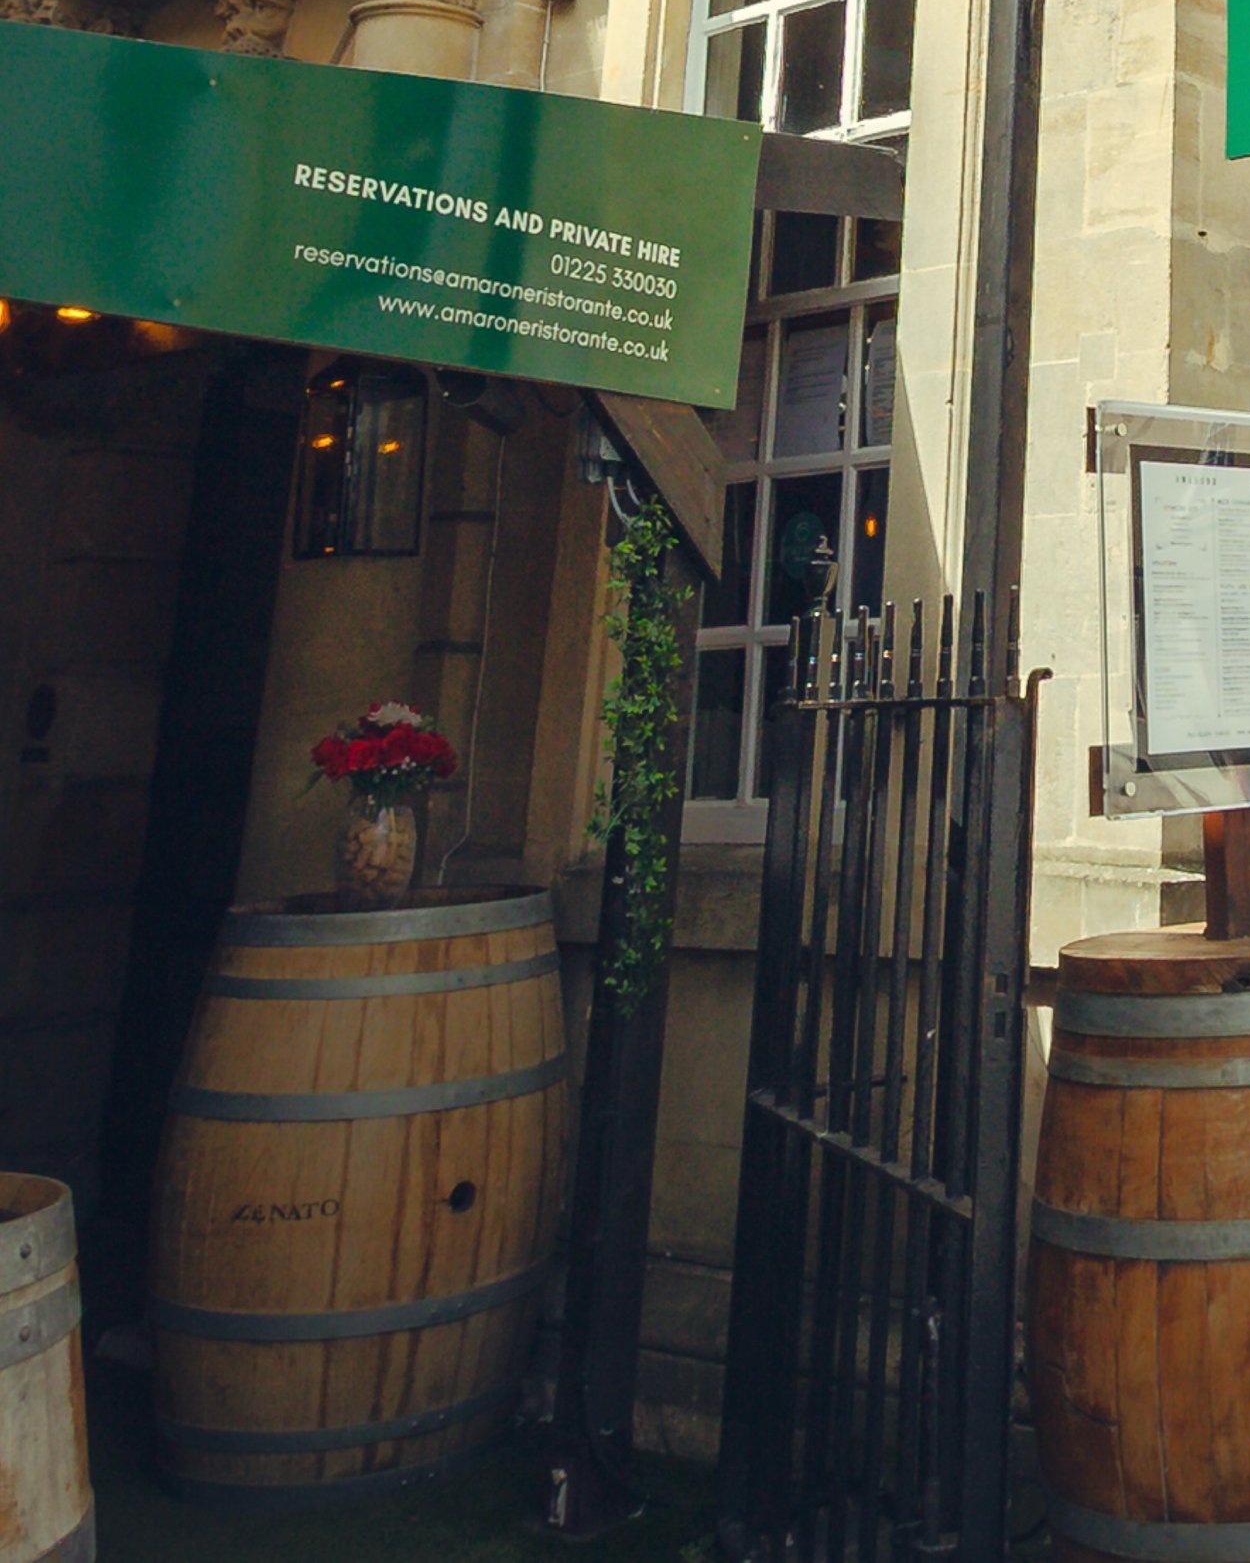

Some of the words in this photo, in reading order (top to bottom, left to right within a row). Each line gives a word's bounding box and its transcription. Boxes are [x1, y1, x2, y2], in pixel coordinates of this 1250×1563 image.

[294, 163, 489, 223] RESERVATIONS
[494, 207, 544, 235] AND
[549, 218, 632, 257] PRIVATE
[637, 239, 681, 268] HIRE
[294, 242, 673, 331] reservations@amaroneristorante.co.uk
[550, 253, 607, 284] 01225
[612, 266, 677, 299] 330030
[378, 294, 669, 362] www.amaroneristorante.co.uk
[231, 1199, 340, 1224] ZENATO
